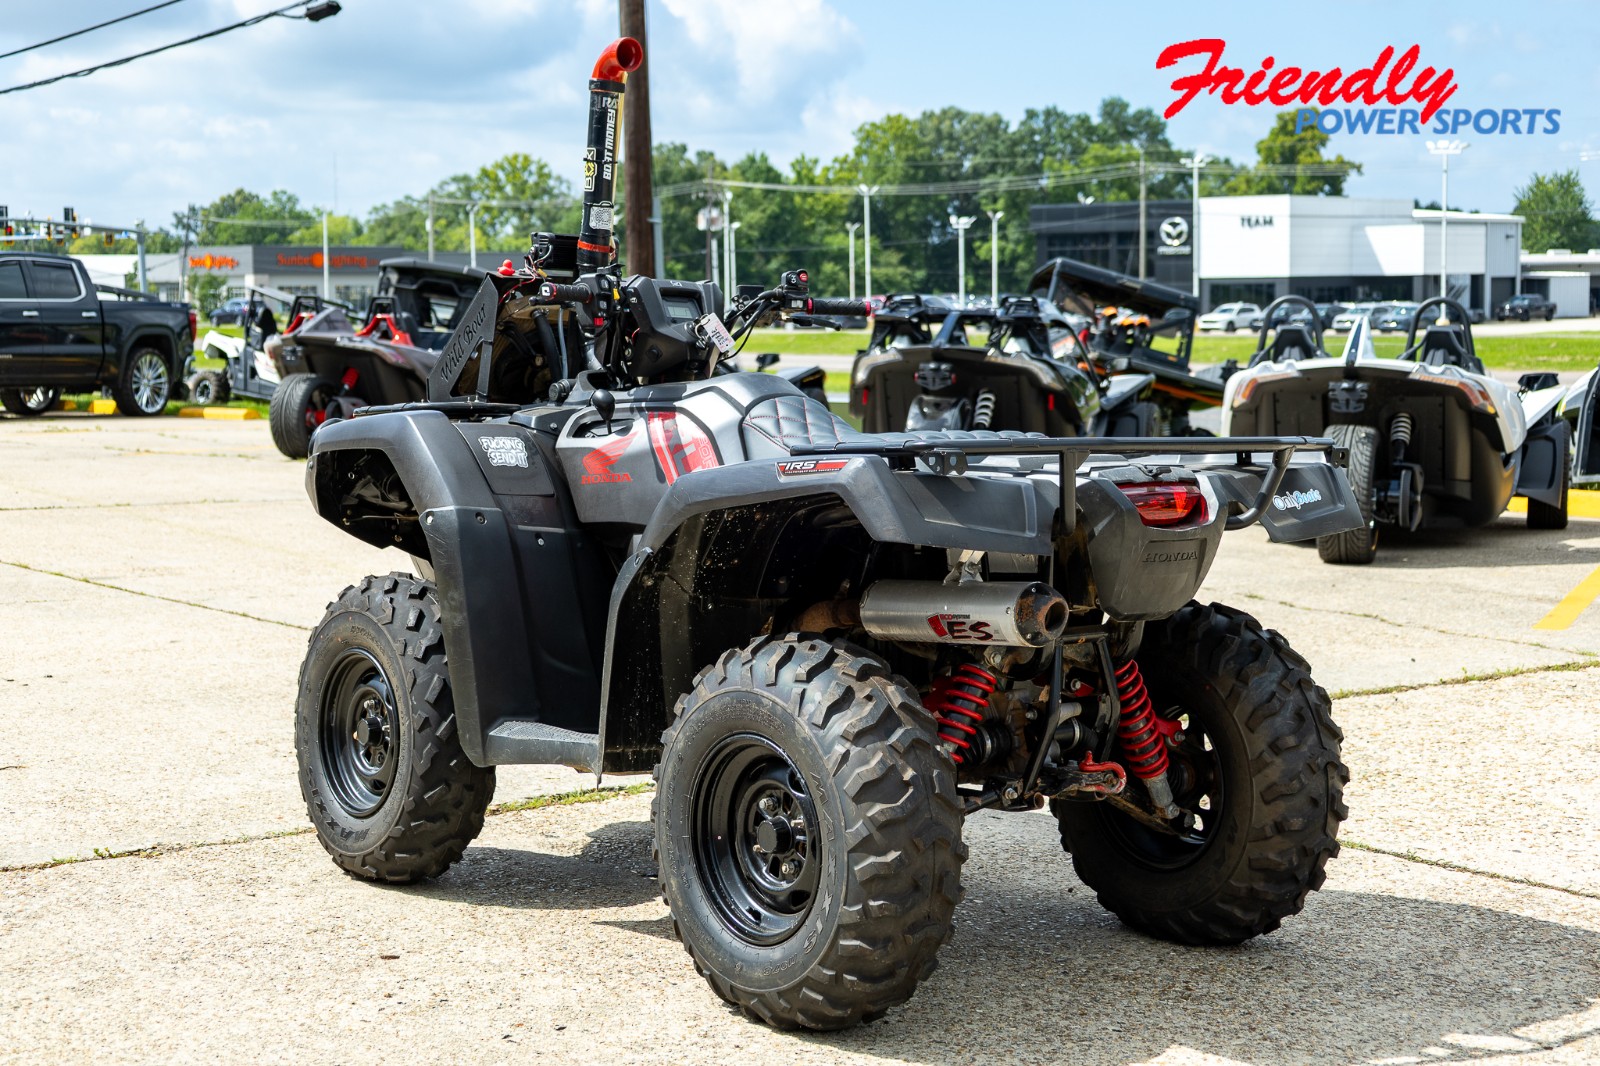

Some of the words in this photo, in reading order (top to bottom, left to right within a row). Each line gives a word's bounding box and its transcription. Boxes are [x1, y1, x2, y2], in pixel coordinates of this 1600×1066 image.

[1240, 215, 1274, 228] TEAM
[481, 438, 523, 450] FUCKING
[489, 451, 516, 464] SEND
[785, 461, 817, 470] IRS
[581, 473, 633, 485] HONDA
[1142, 550, 1198, 563] HONDA
[307, 765, 371, 842] MAXXIS
[803, 771, 837, 954] MAXXIS
